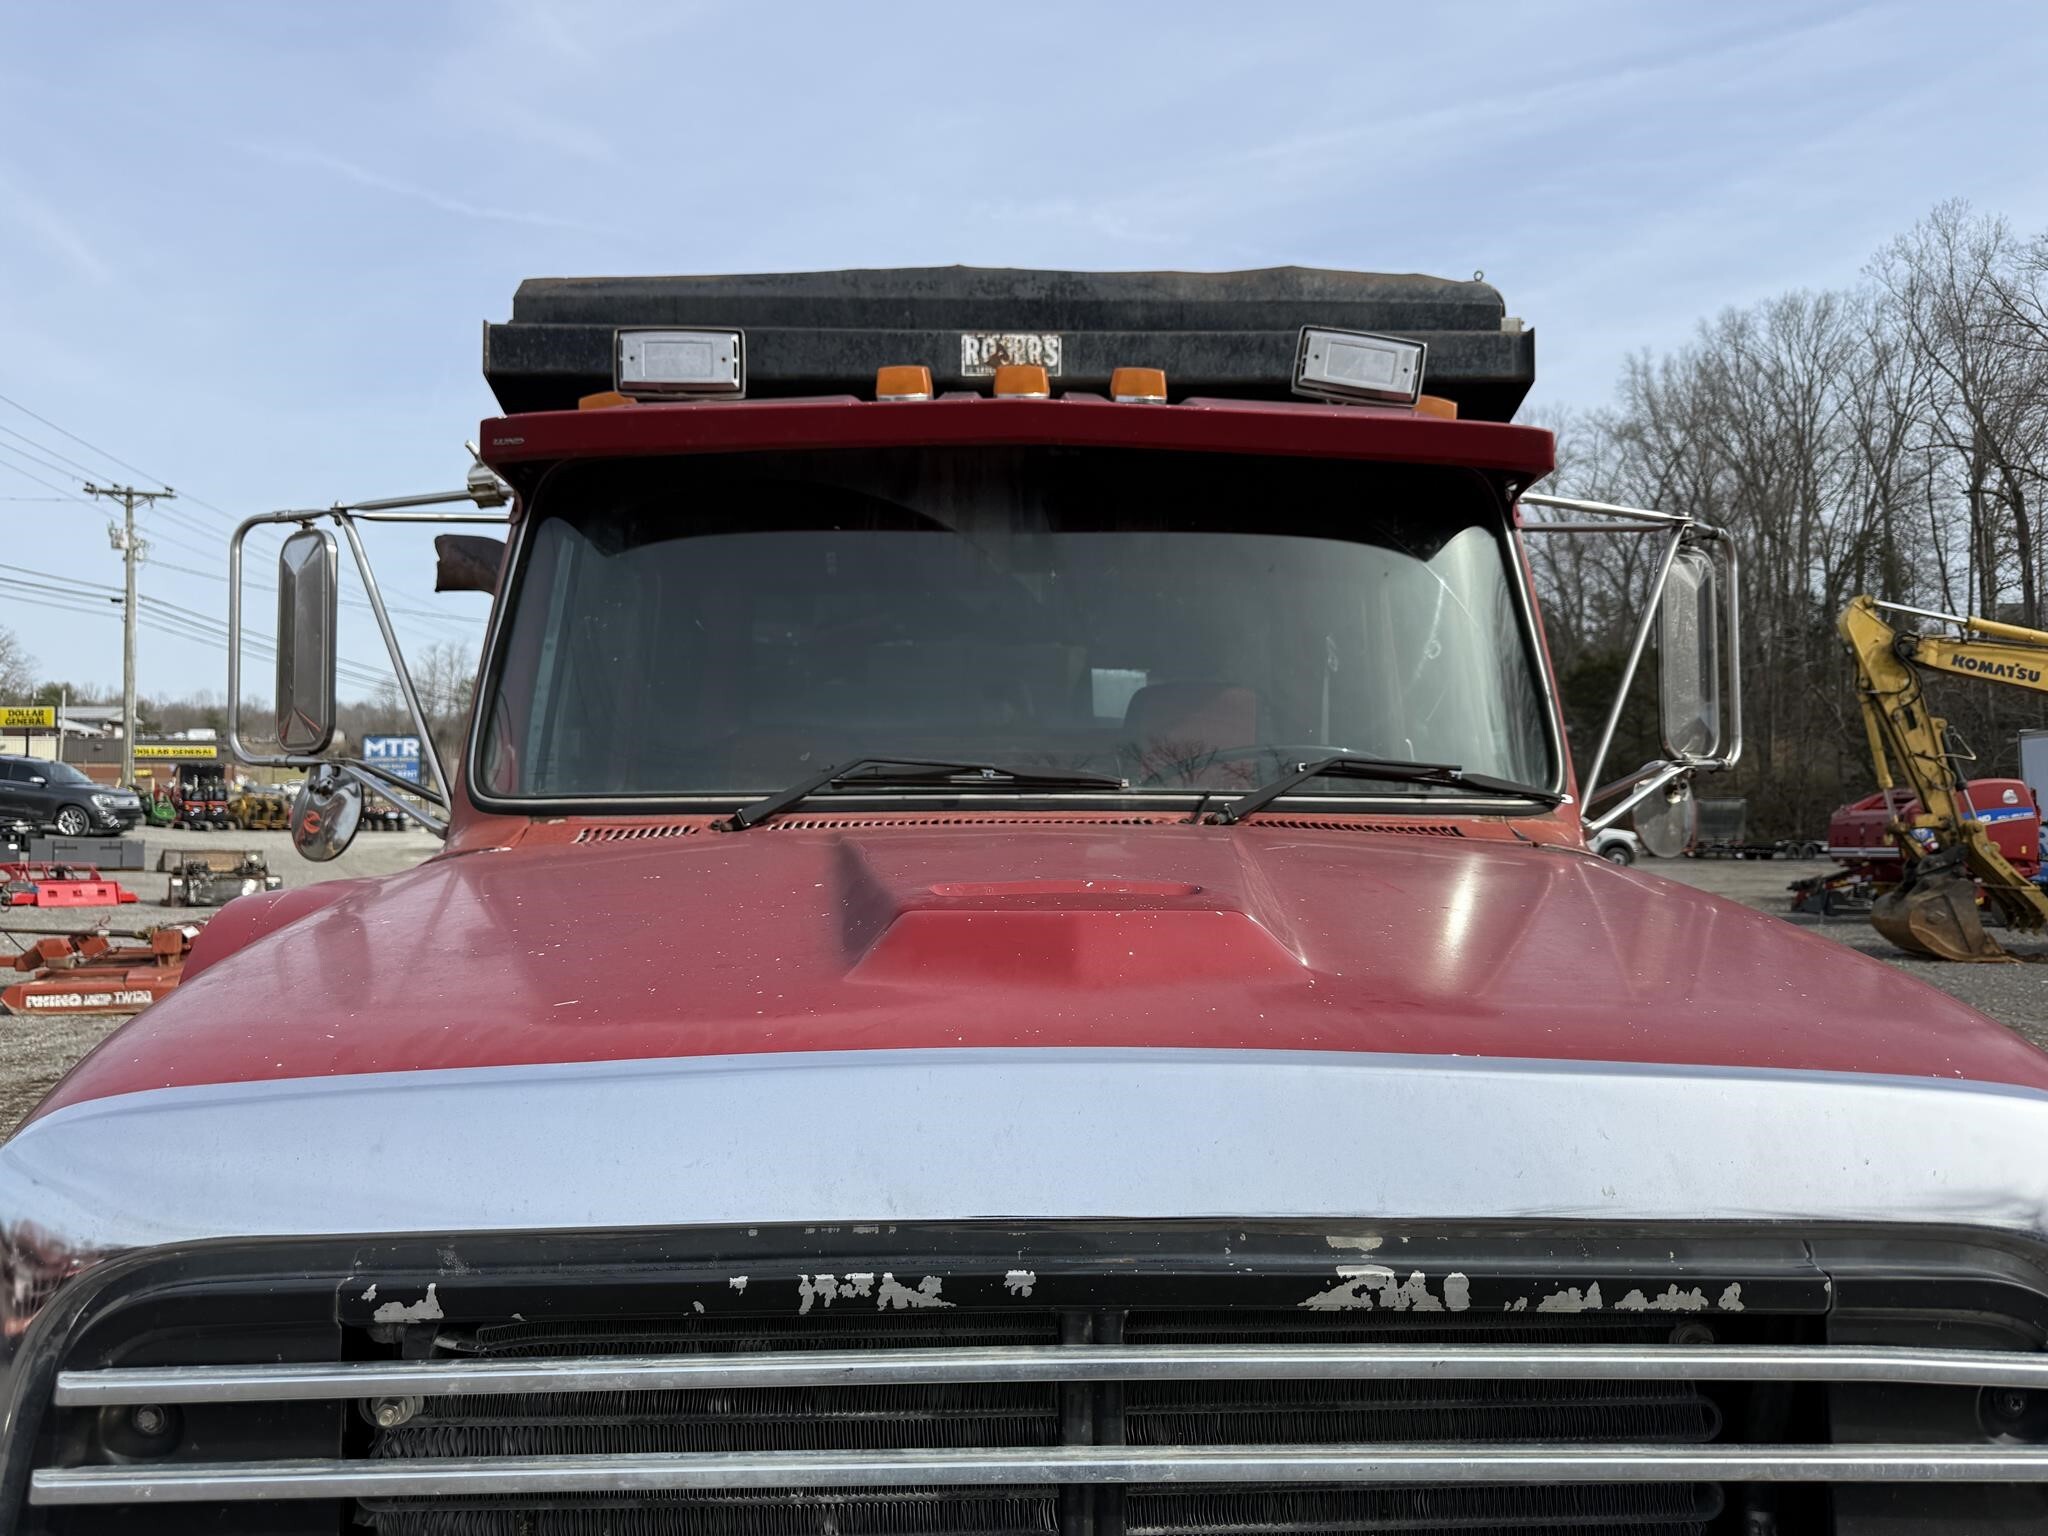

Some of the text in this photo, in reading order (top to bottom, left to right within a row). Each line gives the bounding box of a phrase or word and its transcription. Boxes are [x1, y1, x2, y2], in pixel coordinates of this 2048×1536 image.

[1951, 654, 2041, 683] KOMATSU
[7, 709, 45, 717] DOLLAR
[5, 717, 47, 726] GENERAL
[172, 747, 212, 756] GENERAL
[364, 737, 420, 757] MTR
[25, 993, 83, 1008] RHINO
